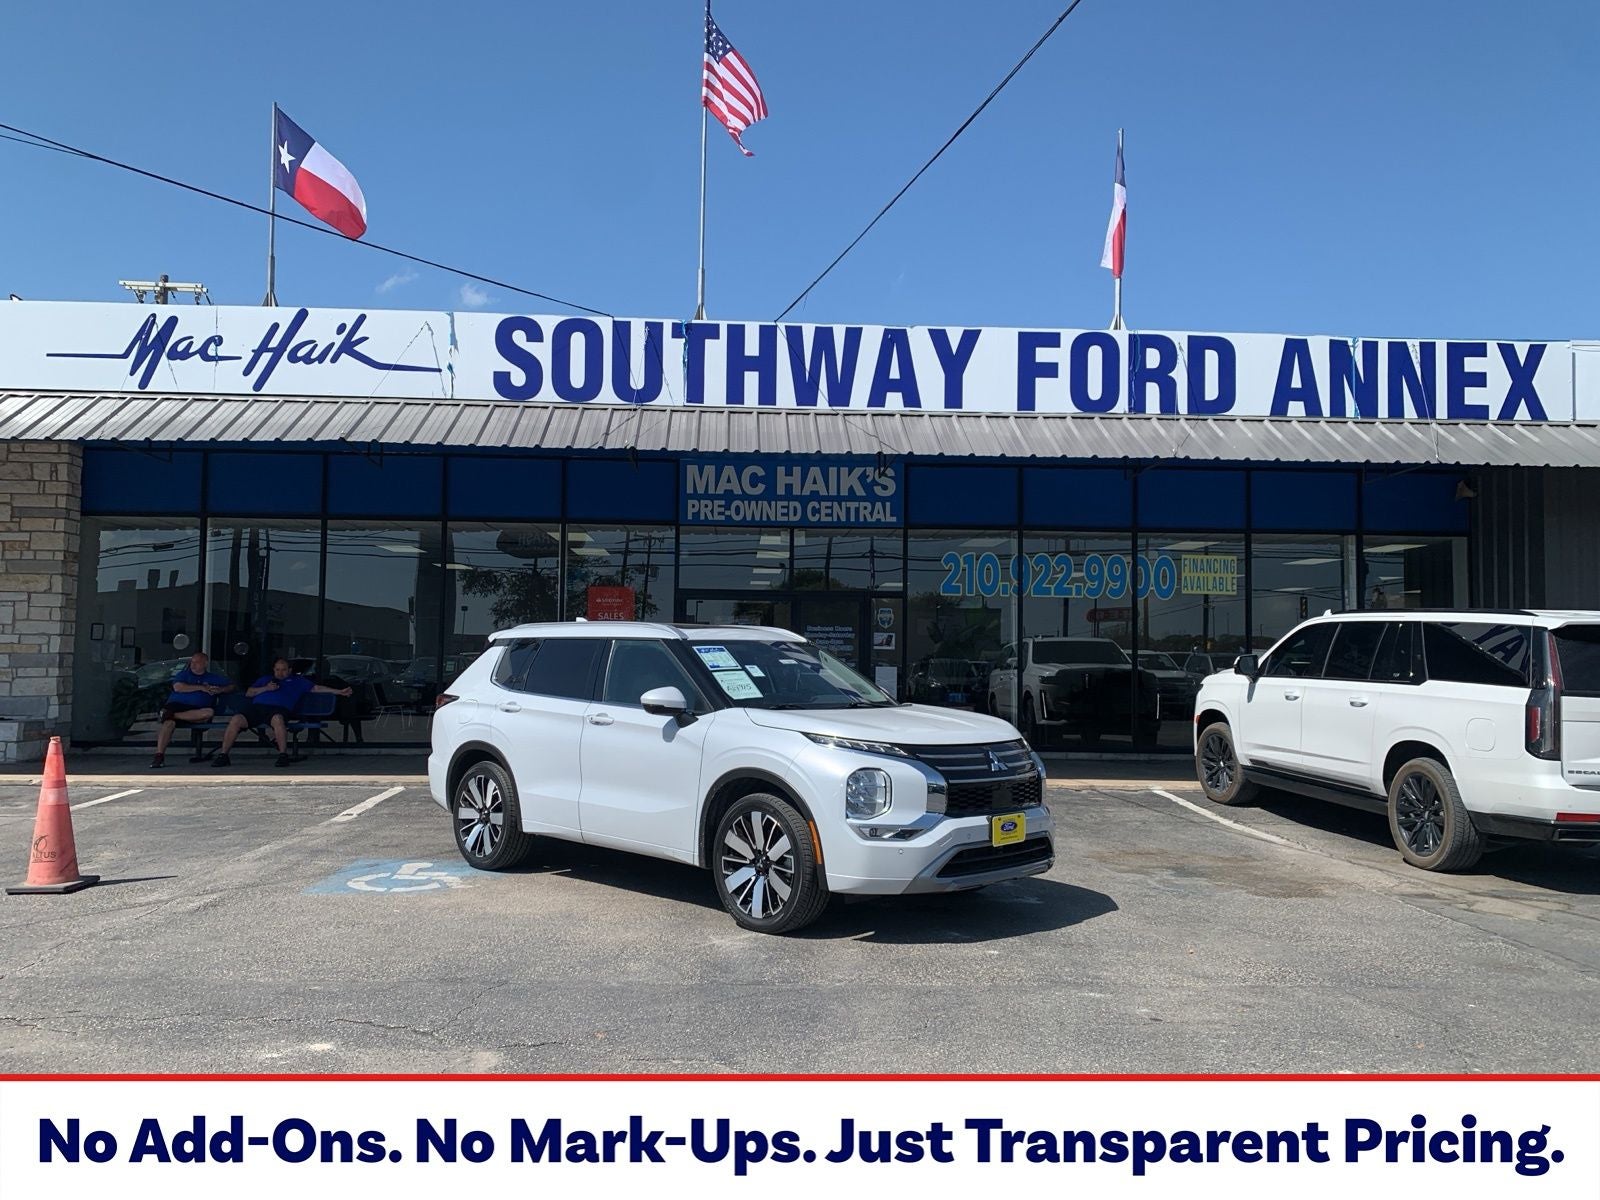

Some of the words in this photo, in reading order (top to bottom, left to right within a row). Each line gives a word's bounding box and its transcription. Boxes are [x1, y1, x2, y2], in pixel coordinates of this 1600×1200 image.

[46, 313, 242, 390] Mac
[243, 308, 442, 392] Haik
[493, 315, 981, 410] SOUTHWAY
[1017, 331, 1237, 417] FORD
[1271, 337, 1548, 421] ANNEX
[686, 464, 766, 496] MAC
[776, 466, 896, 497] HAIK'S
[687, 499, 802, 522] PRE-OWNED
[807, 501, 897, 522] CENTRAL
[940, 551, 1178, 600] 210.922.9900
[1182, 557, 1236, 575] FINANCING
[1182, 575, 1237, 593] AVAILABLE
[598, 612, 625, 621] SALES
